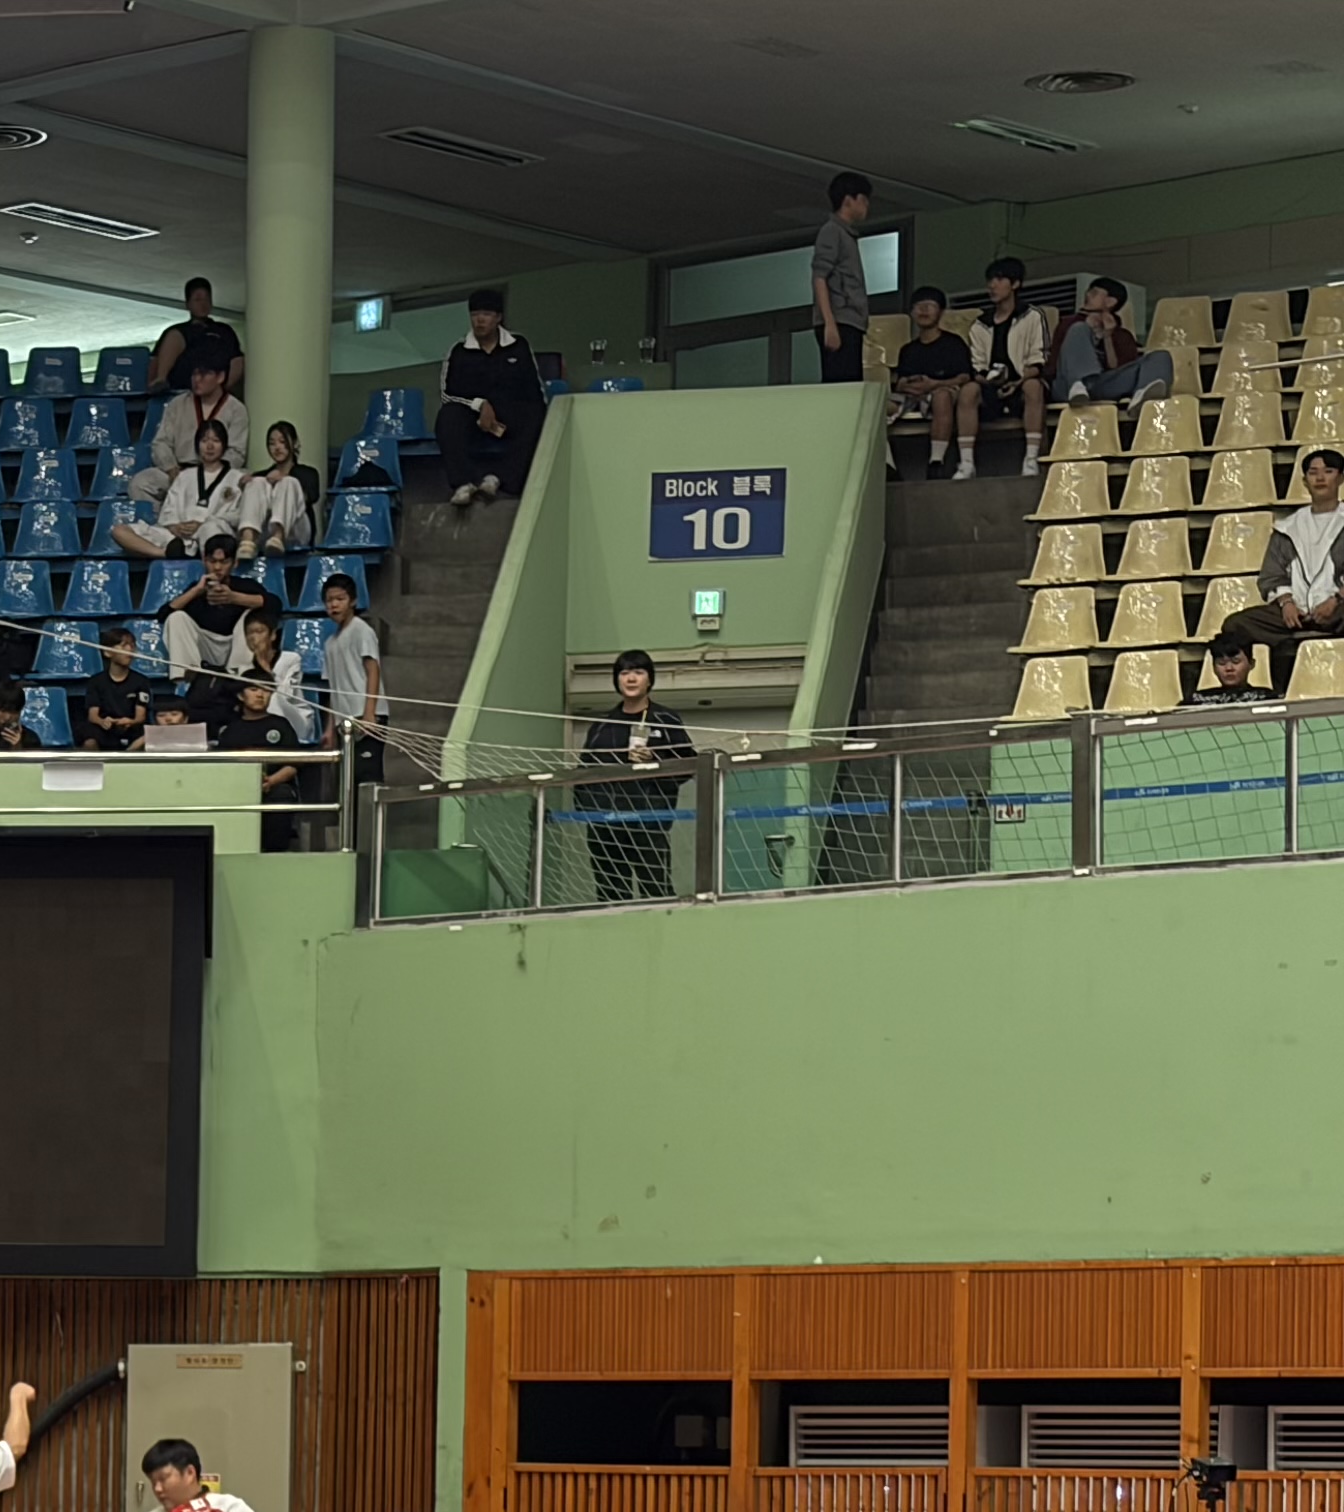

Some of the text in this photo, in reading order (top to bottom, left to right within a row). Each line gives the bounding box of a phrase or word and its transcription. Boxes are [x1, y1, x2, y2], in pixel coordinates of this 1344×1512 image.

[665, 475, 772, 498] Block 블록
[683, 506, 751, 550] 10
